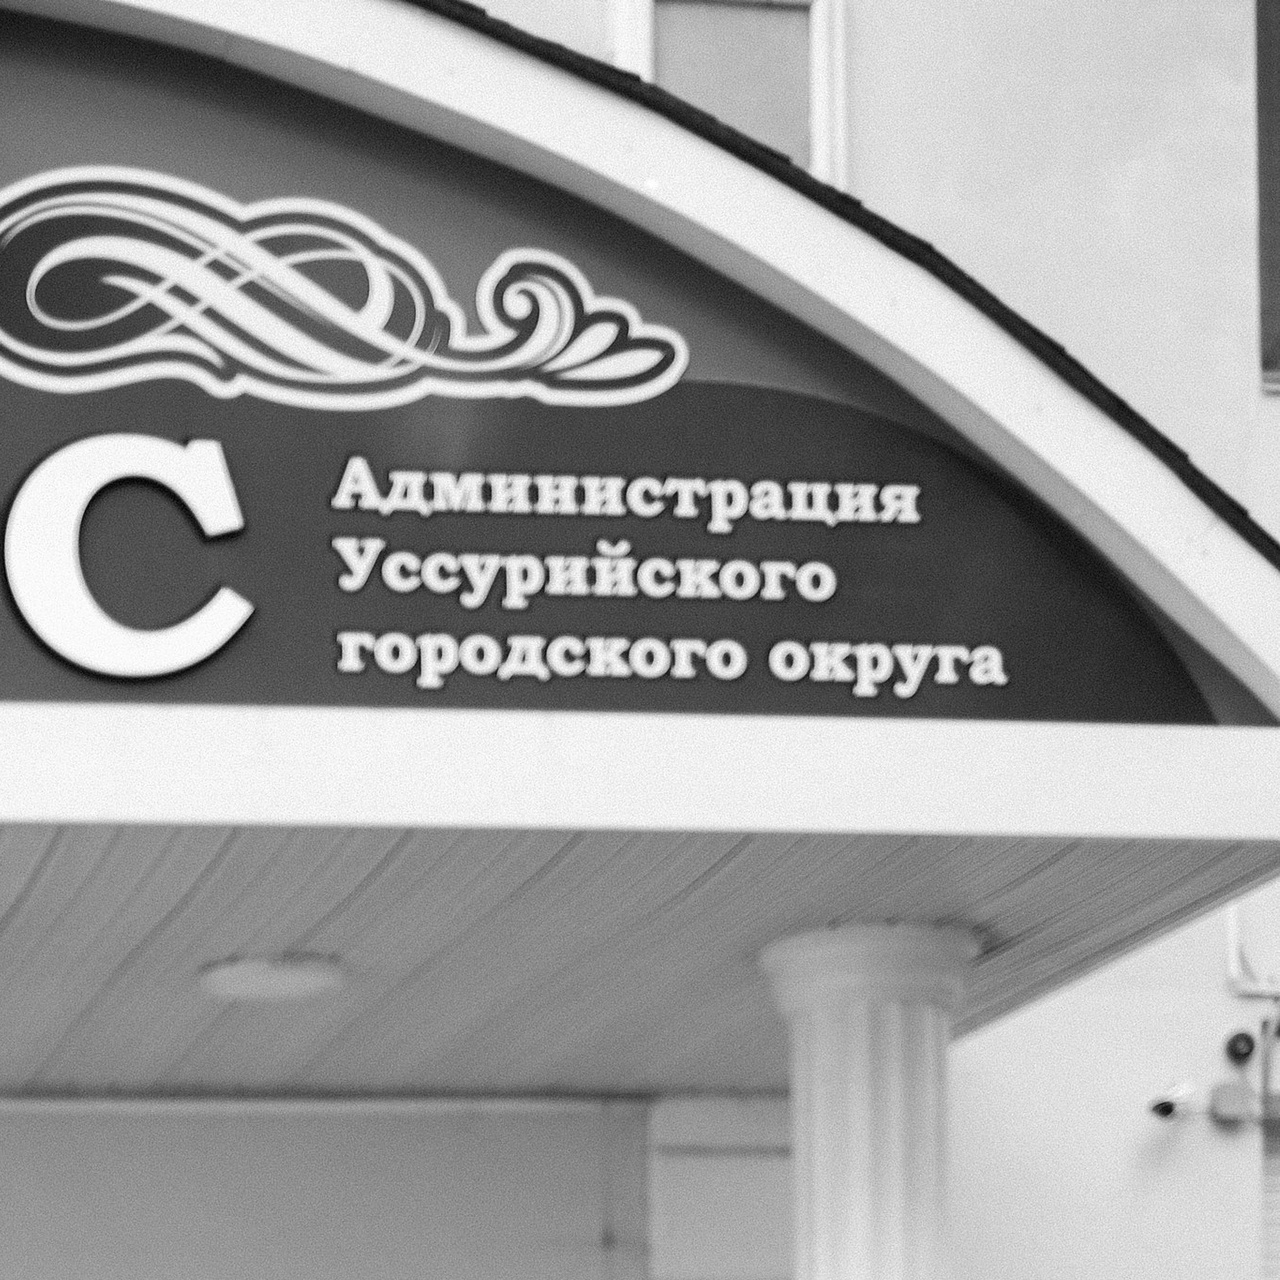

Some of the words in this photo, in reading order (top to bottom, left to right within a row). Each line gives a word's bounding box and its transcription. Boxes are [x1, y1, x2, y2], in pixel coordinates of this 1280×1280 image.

[331, 456, 920, 533] Администрация
[332, 537, 837, 609] Уссурийского
[337, 631, 748, 689] городского
[768, 641, 1008, 698] округа
